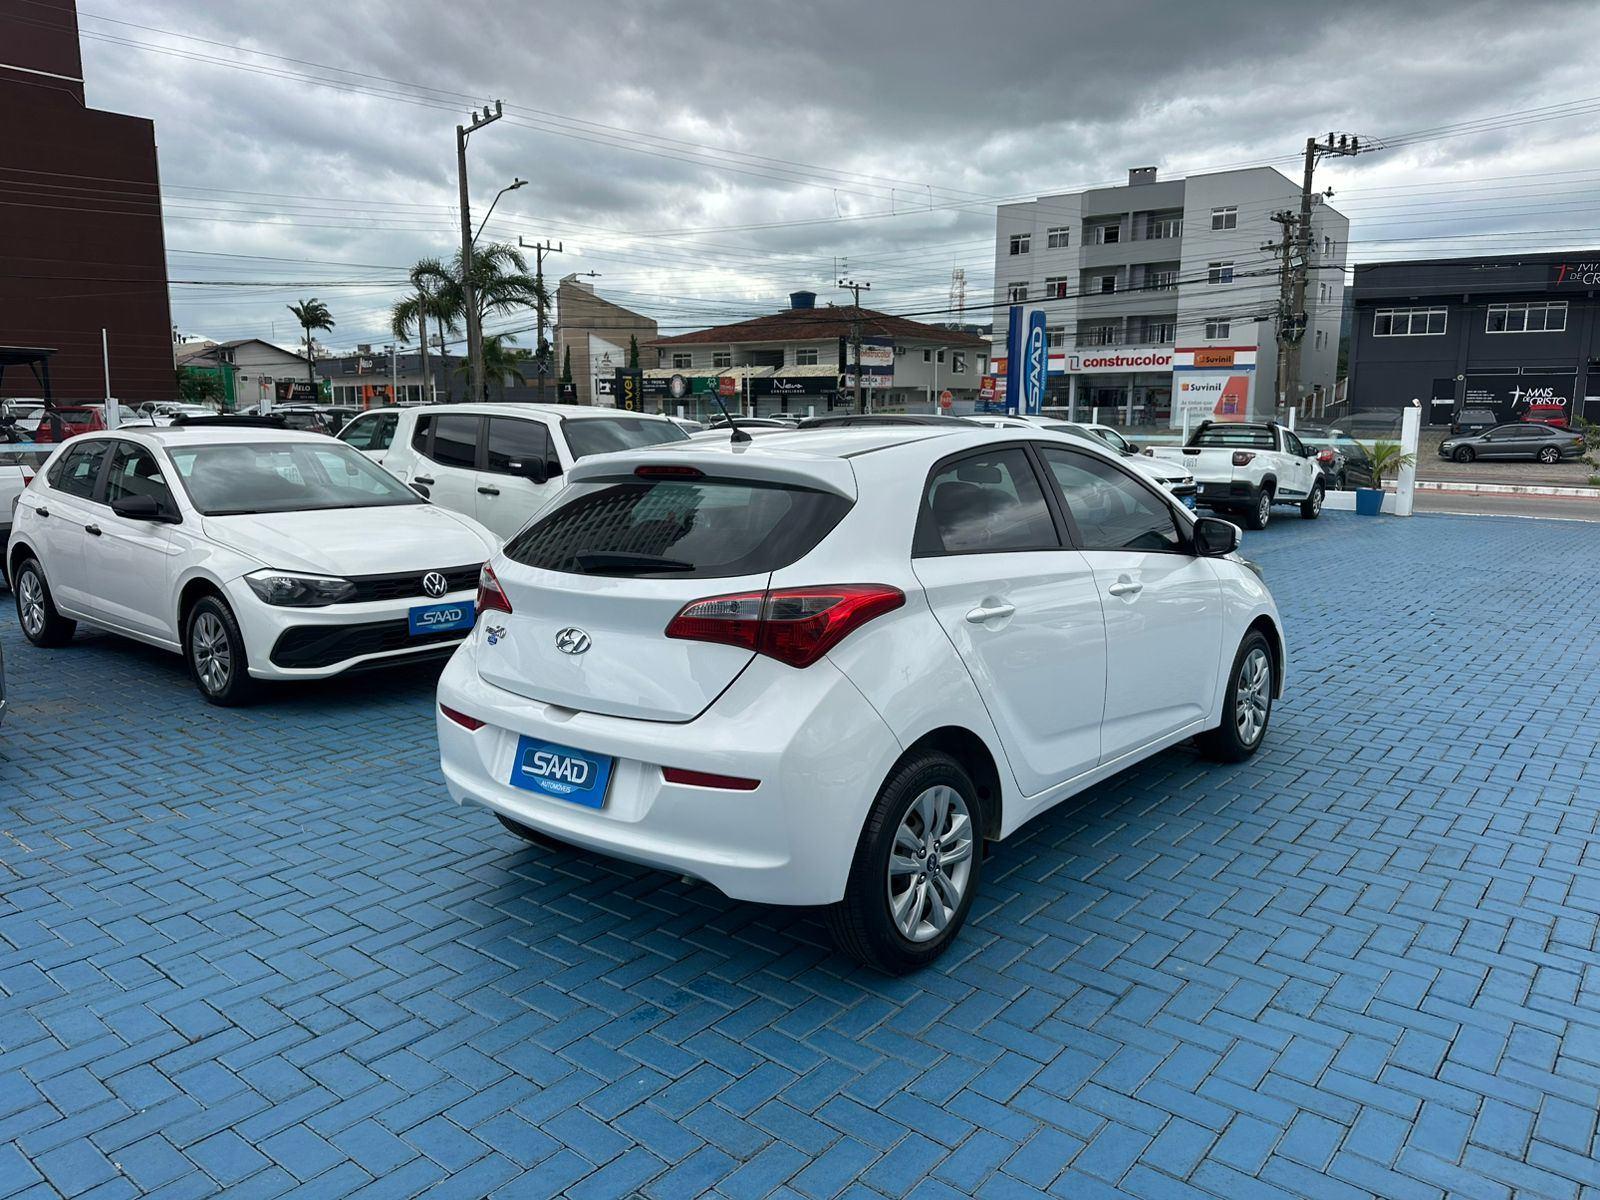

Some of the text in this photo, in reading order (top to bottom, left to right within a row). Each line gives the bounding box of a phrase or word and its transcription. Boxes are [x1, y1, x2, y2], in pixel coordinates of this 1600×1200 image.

[1083, 354, 1172, 368] construcolor
[1205, 355, 1232, 364] Suvinil
[1029, 326, 1042, 415] SAAD
[293, 383, 311, 391] MELO
[1190, 383, 1221, 392] Suvinil
[1526, 387, 1553, 397] MAIS
[1529, 397, 1567, 406] CRISTO
[416, 609, 462, 626] SAAD
[522, 751, 589, 784] SAAD
[540, 780, 571, 793] AUTOMÓVEIS
